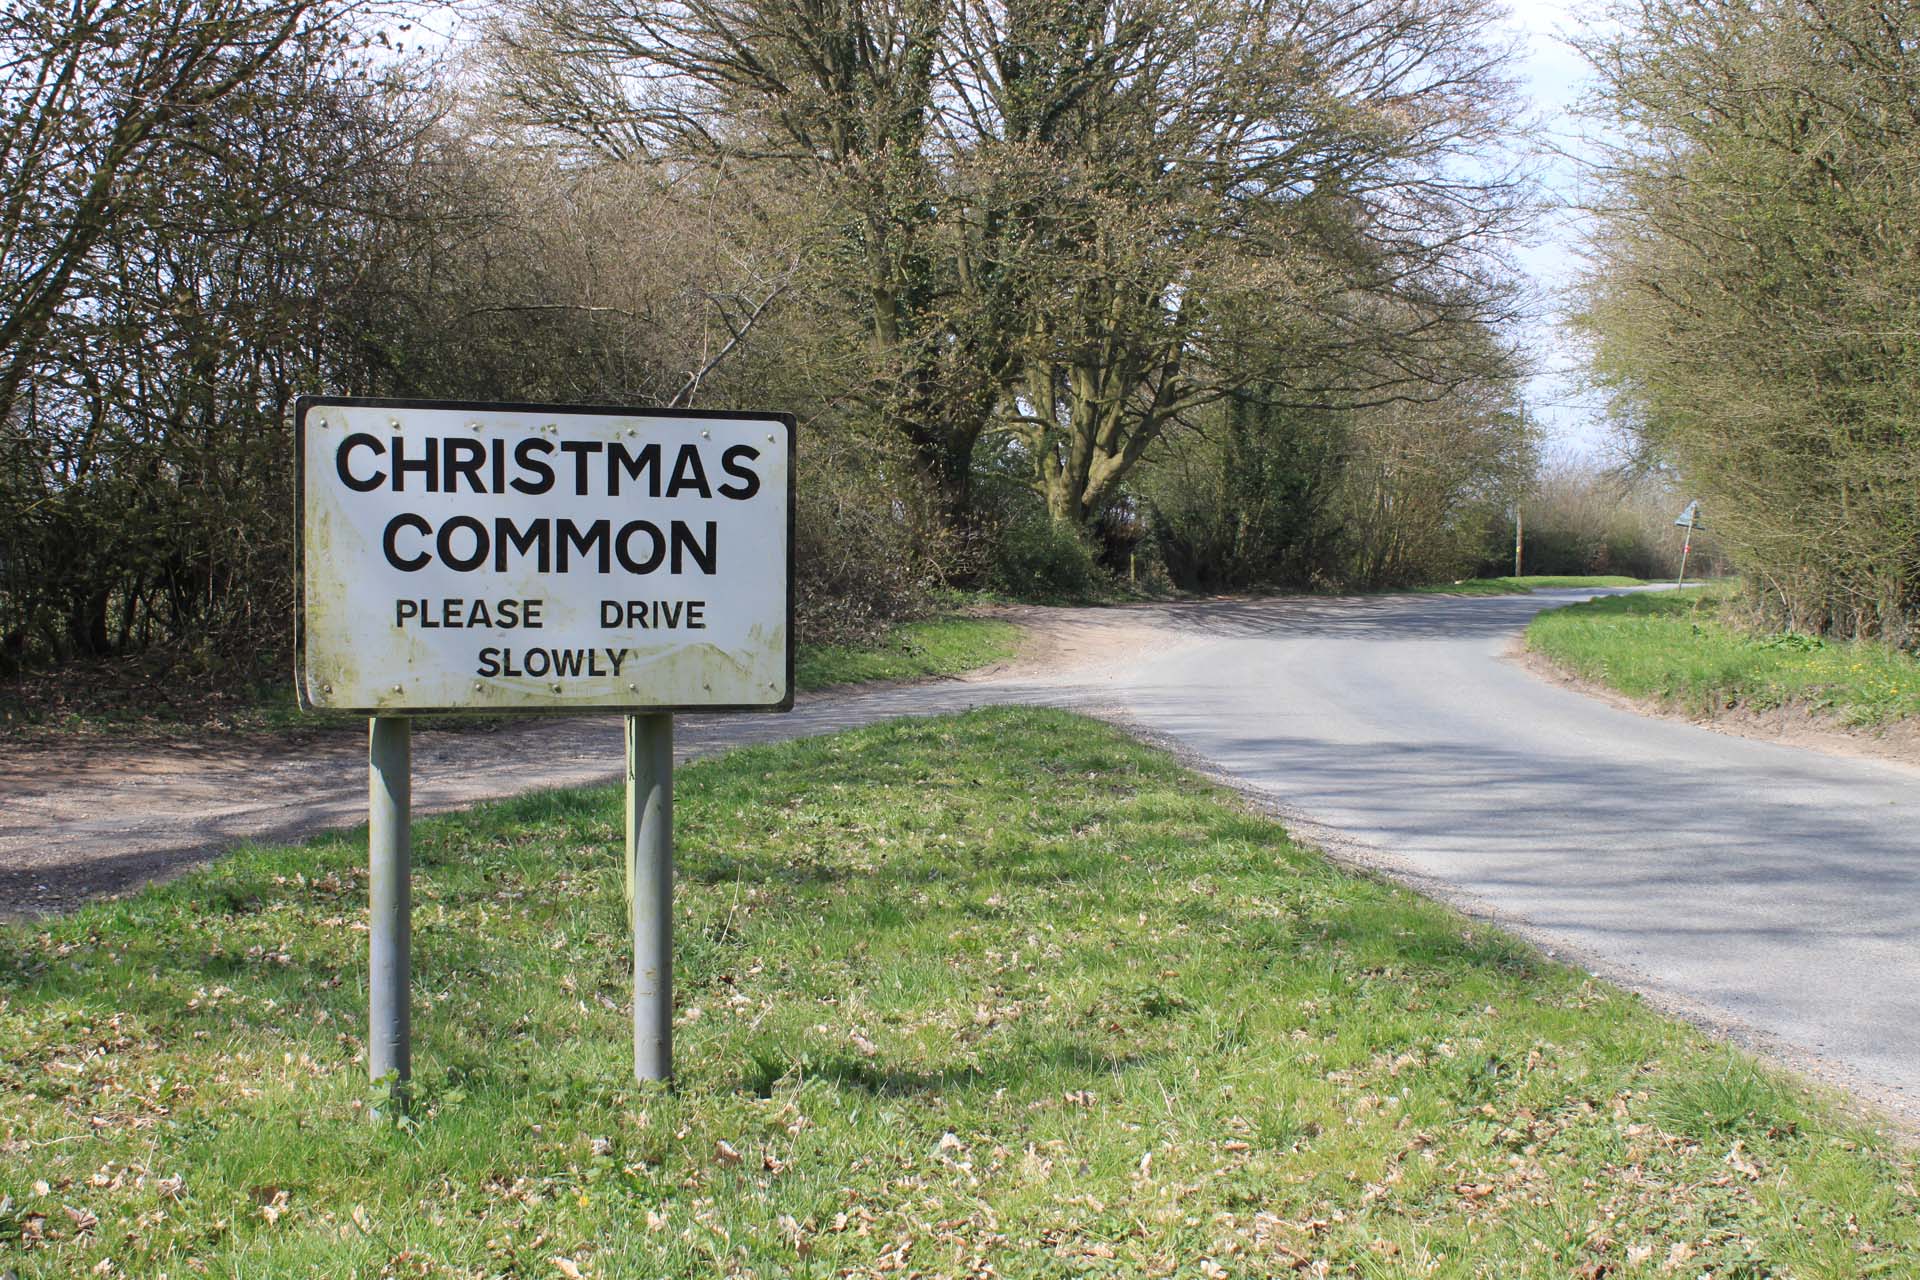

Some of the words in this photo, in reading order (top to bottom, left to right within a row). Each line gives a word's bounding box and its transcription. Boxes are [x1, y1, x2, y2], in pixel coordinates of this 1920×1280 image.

[336, 433, 760, 500] CHRISTMAS
[383, 513, 717, 575] COMMON
[396, 599, 543, 629] PLEASE
[601, 600, 706, 629] DRIVE
[477, 647, 629, 678] SLOWLY
